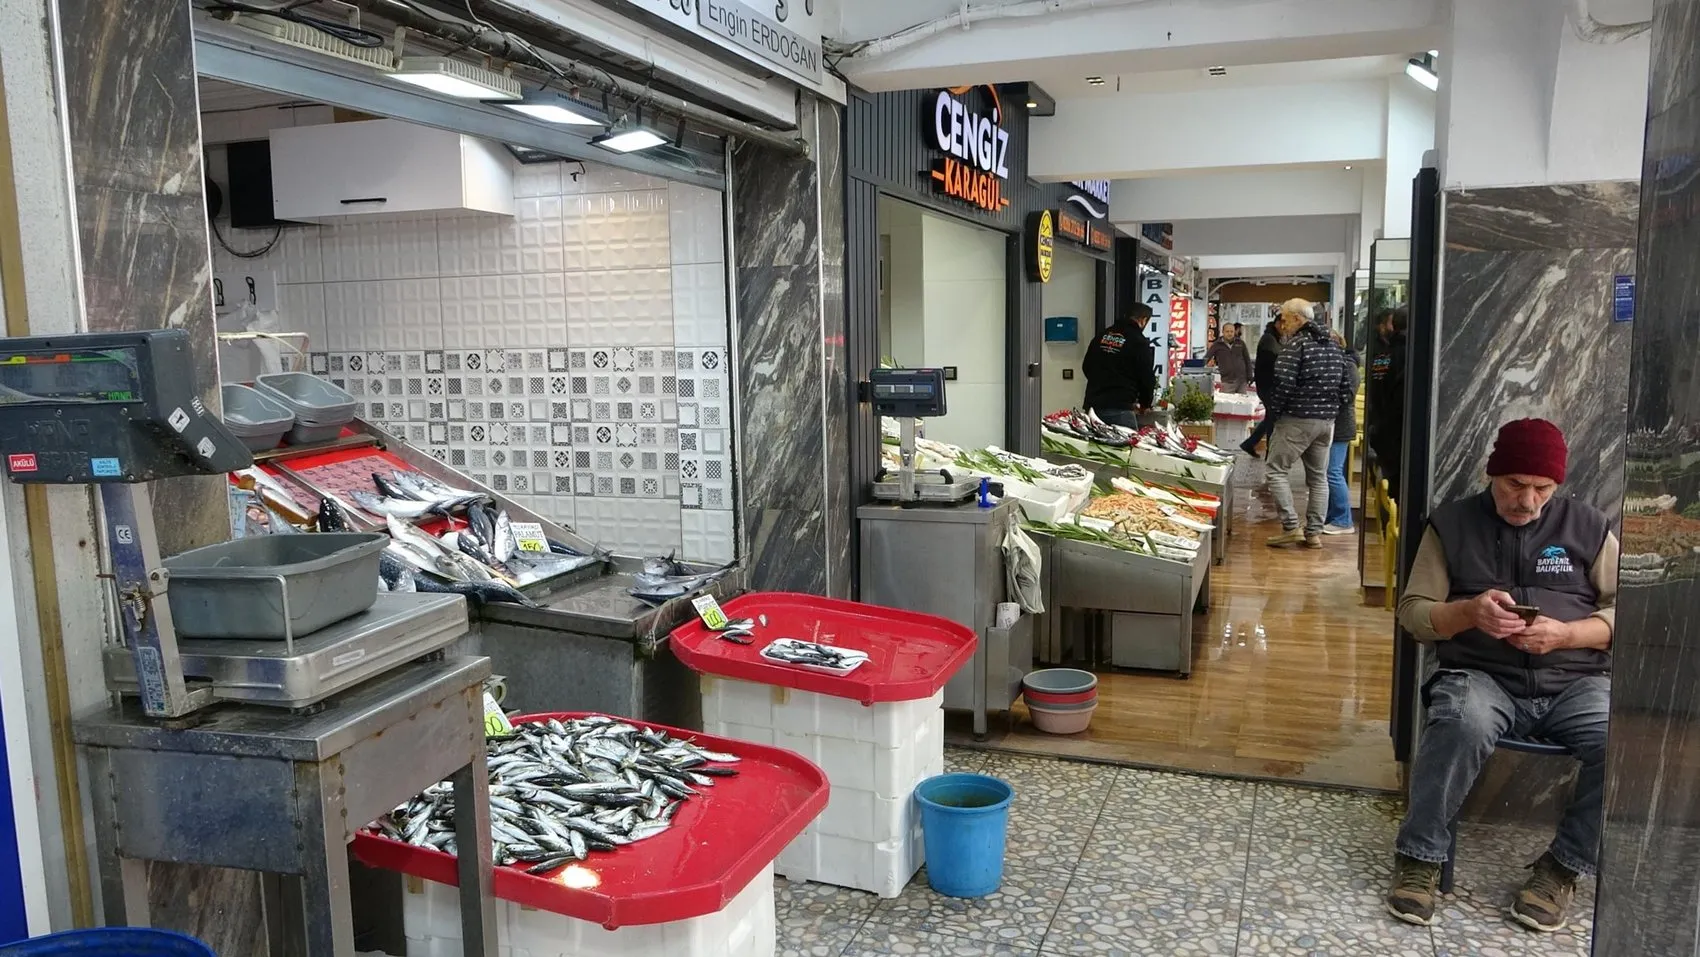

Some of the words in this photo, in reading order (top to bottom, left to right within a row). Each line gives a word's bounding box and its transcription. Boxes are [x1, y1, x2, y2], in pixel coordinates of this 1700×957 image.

[708, 0, 748, 38] Engin
[752, 19, 818, 73] ERDOĞAN
[935, 91, 1009, 180] CENGİZ
[944, 157, 1002, 212] KARAGÜL
[13, 458, 35, 468] AKÜLÜ
[118, 529, 131, 540] CE
[1536, 565, 1573, 573] BALIKÇILIK
